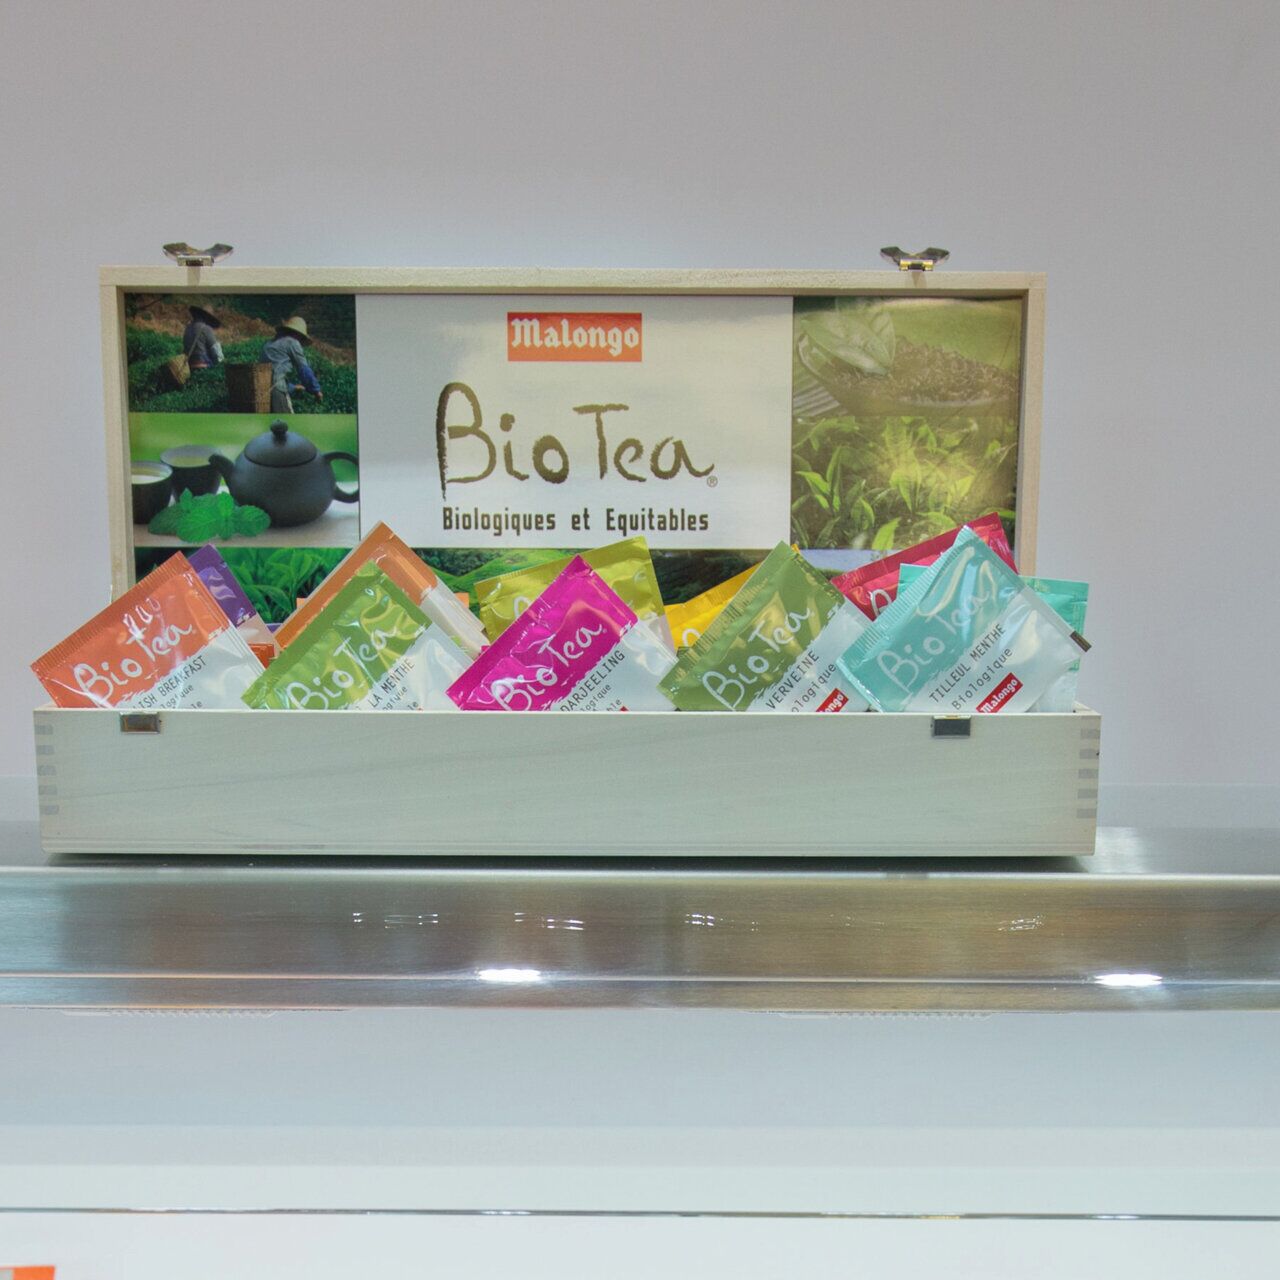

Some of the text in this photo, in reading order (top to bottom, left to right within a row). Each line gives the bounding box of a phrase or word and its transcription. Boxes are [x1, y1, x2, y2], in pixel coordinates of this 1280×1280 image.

[510, 317, 640, 357] Malongo
[442, 506, 710, 537] Biologiques et Equitables
[133, 654, 208, 709] LISH BREAKFAST
[380, 657, 416, 693] MENTHE
[559, 650, 627, 711] DARJEELING
[765, 650, 820, 710] VERVEINE
[792, 661, 837, 712] ologique
[929, 623, 1007, 705] TILLEUL MENTHE
[951, 647, 1014, 712] Biologique
[581, 683, 613, 711] logique
[820, 692, 845, 712] ongo
[979, 677, 1020, 713] Malongo
